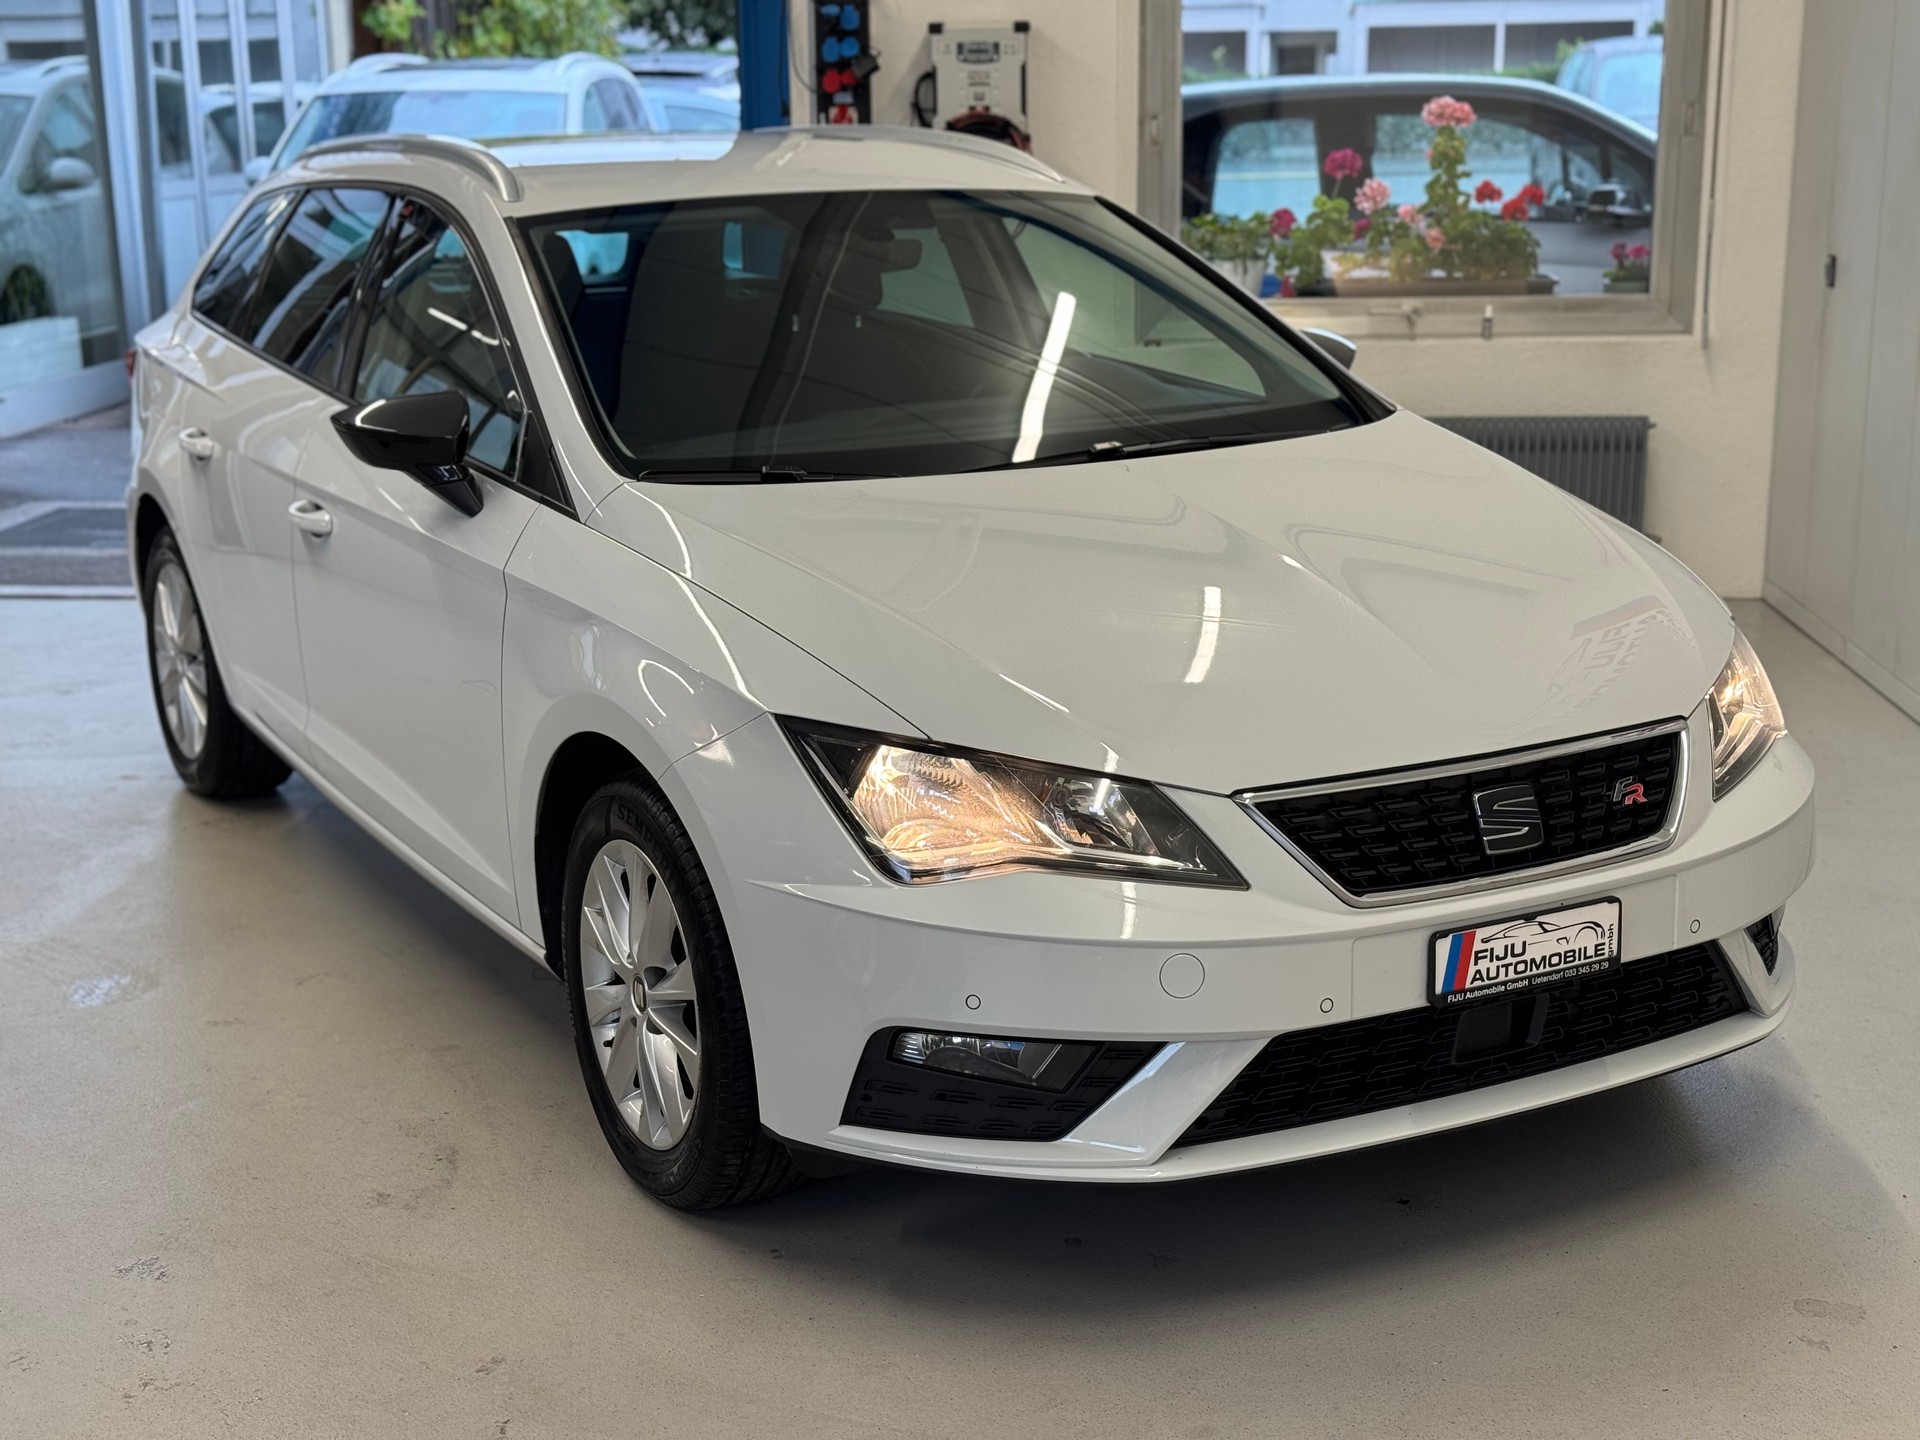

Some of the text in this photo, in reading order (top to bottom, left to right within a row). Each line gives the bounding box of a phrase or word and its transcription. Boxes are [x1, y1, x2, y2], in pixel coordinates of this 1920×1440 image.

[1613, 776, 1648, 805] FR
[1470, 942, 1606, 985] AUTOMOBILE
[1474, 941, 1526, 966] FIJU
[1447, 961, 1610, 1003] FIJU Automobile GmbH Uetendorf 033 345 29 29
